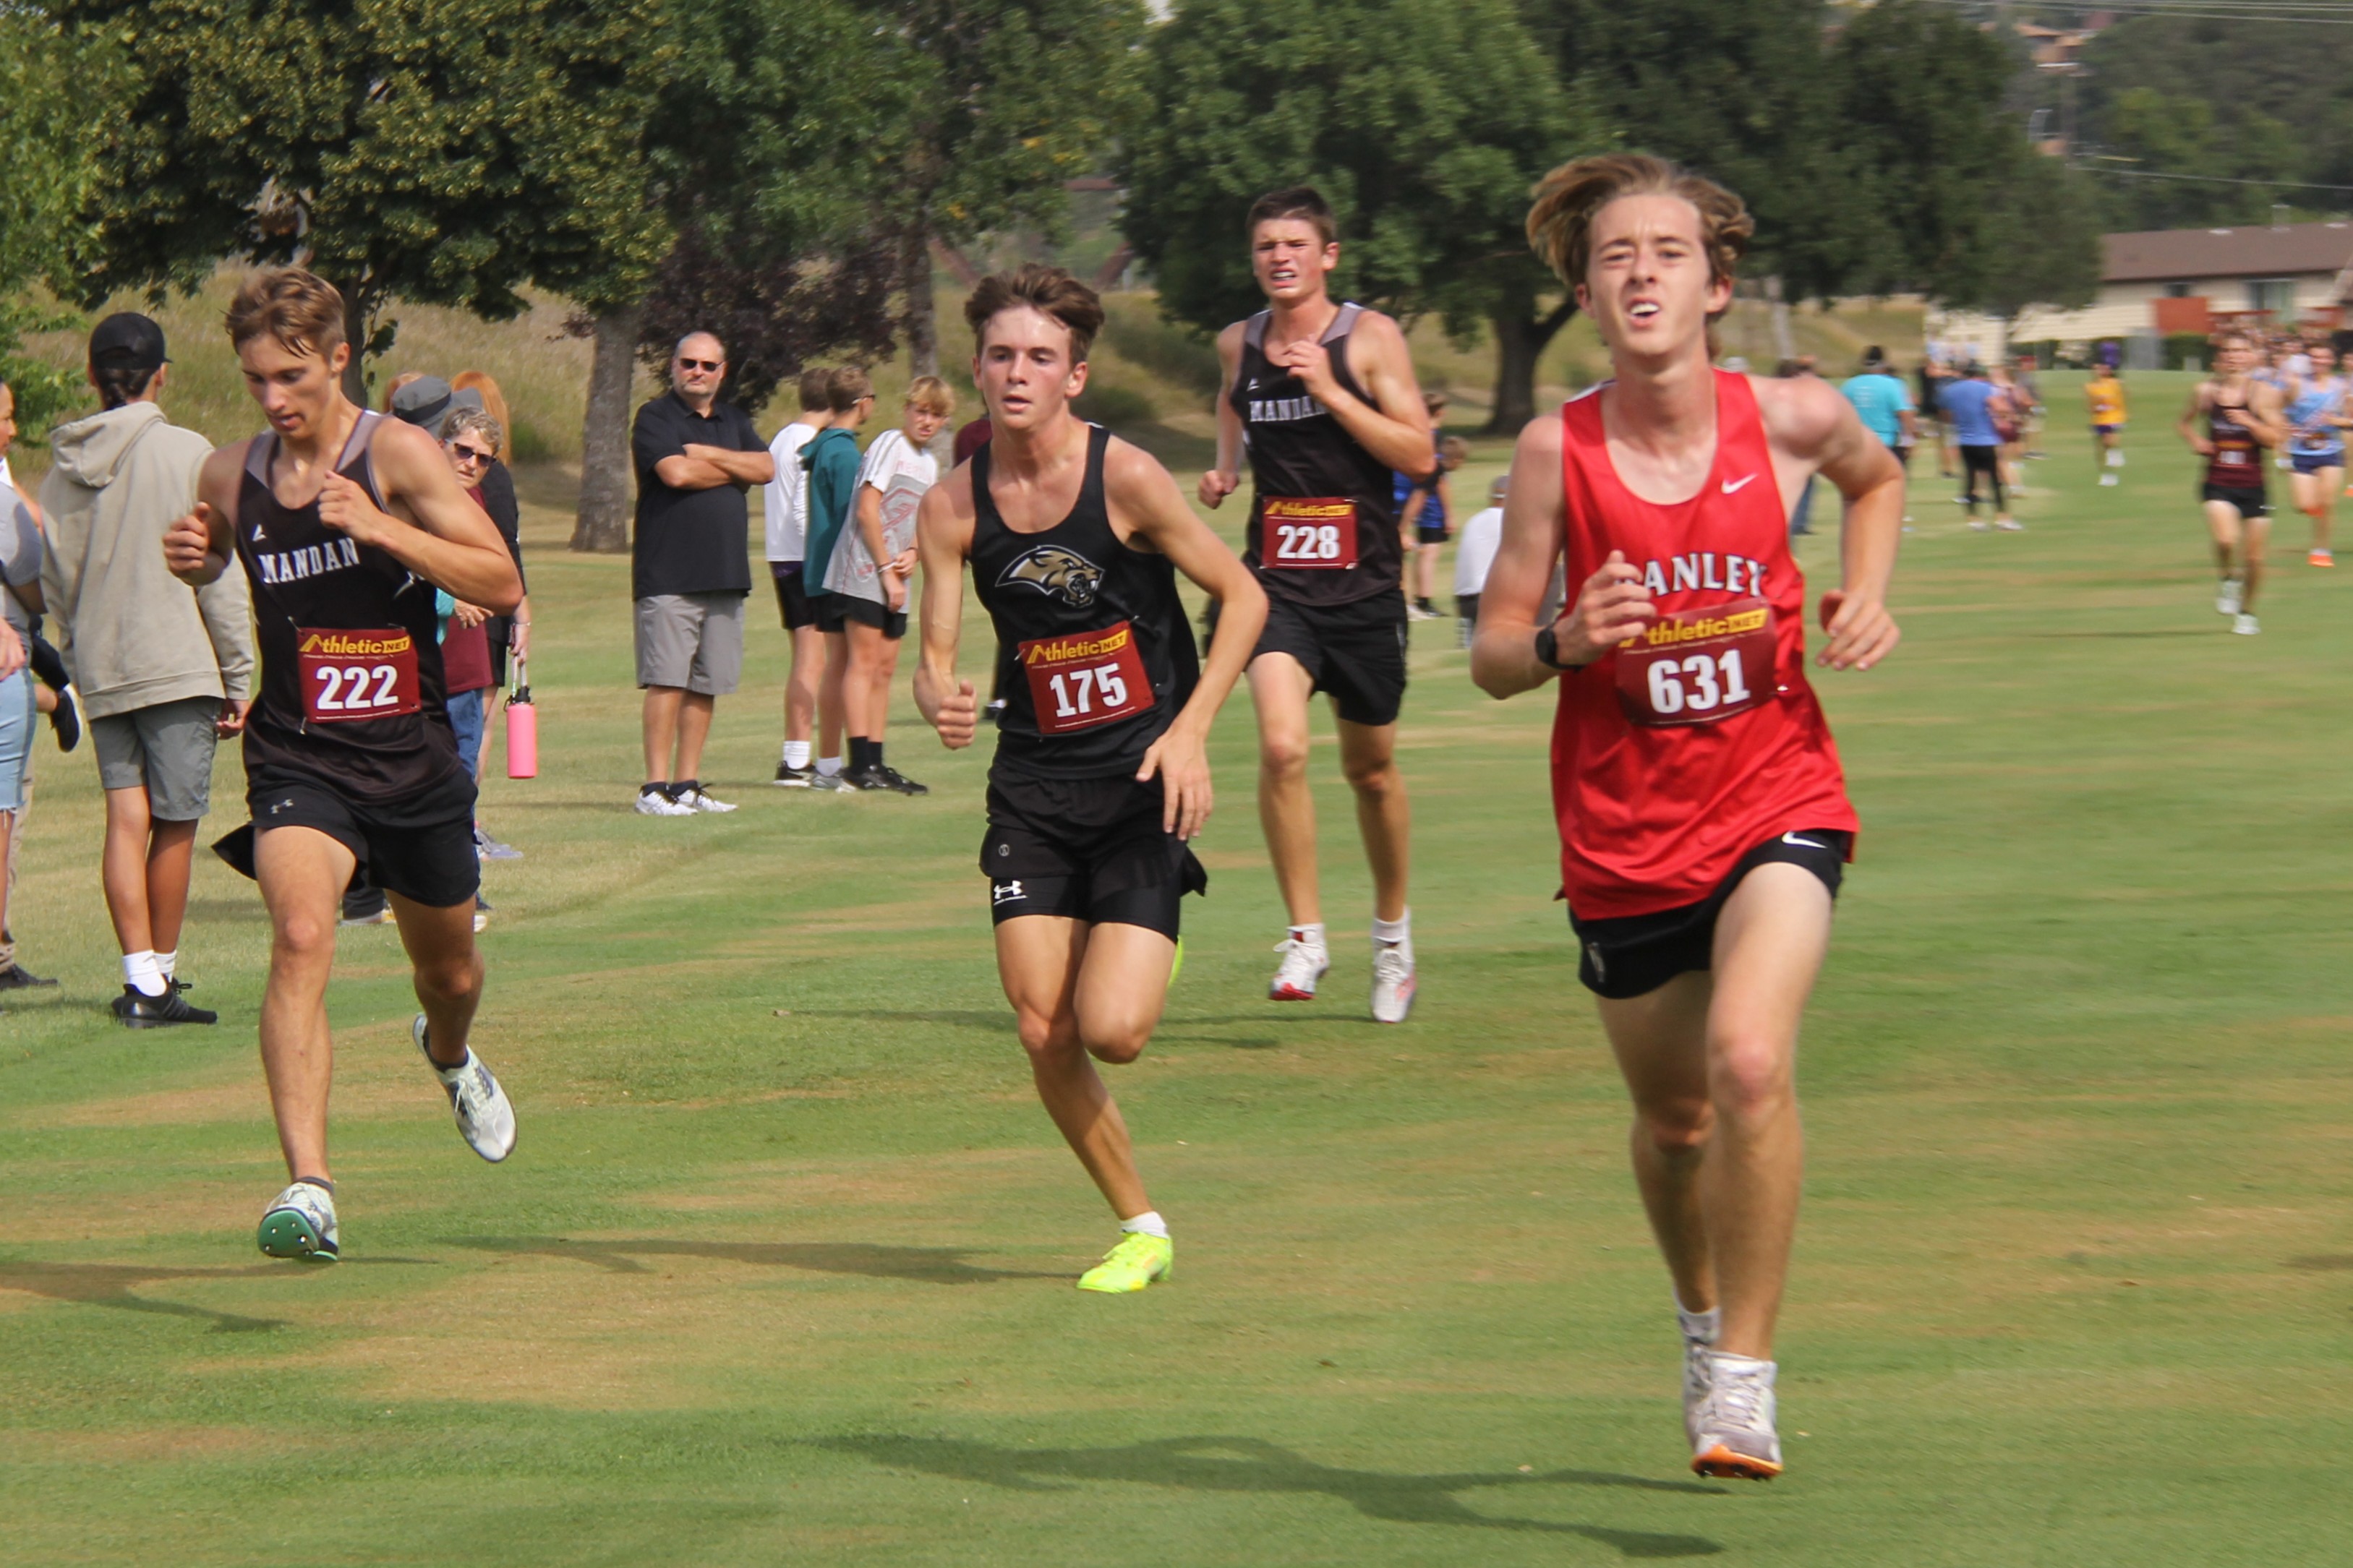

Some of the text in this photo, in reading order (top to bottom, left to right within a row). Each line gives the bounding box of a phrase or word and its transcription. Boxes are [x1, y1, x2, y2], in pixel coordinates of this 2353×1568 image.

[258, 537, 360, 583] MANDAN
[1277, 525, 1340, 560] 228
[1613, 552, 1768, 597] ANLEY
[316, 664, 398, 710] 222
[1049, 662, 1128, 717] 175
[1647, 648, 1750, 714] 631
